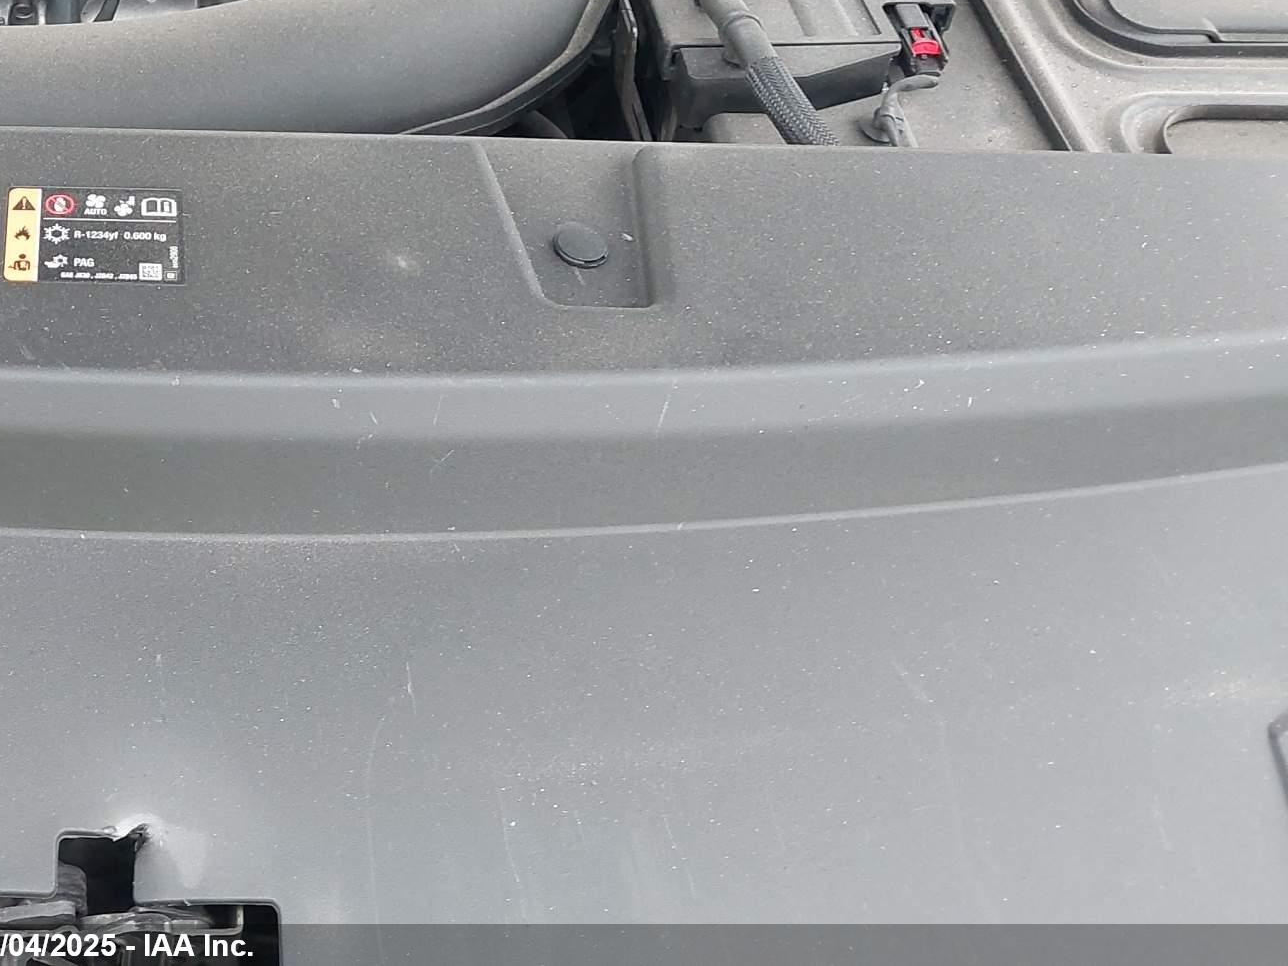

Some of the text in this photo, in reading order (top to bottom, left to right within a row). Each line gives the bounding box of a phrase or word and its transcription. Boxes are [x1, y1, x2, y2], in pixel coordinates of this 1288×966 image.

[84, 208, 108, 216] AUTO
[73, 230, 119, 241] R-1234yf
[153, 231, 167, 243] kg
[73, 257, 95, 268] PAG
